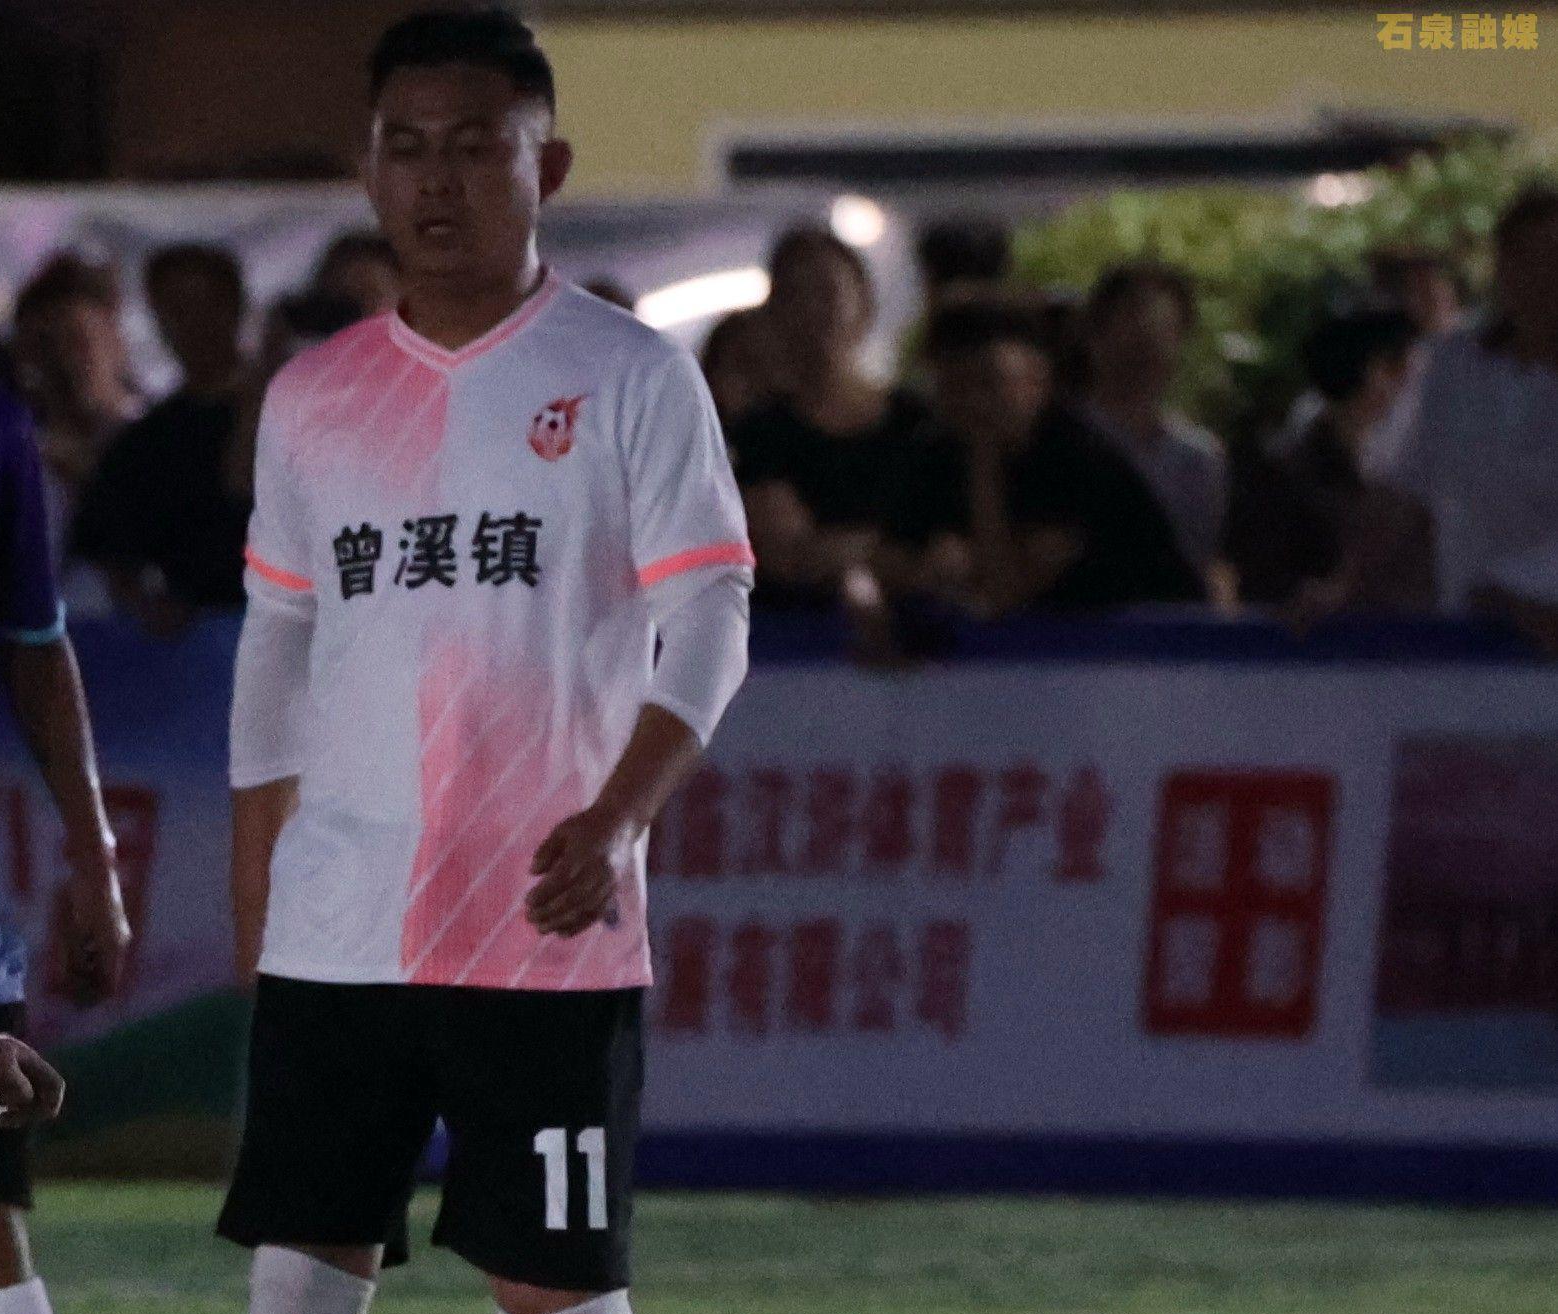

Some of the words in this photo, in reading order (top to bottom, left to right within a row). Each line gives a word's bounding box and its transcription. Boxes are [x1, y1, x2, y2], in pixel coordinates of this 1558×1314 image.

[333, 512, 542, 600] 曾溪镇
[533, 1126, 608, 1230] 11
